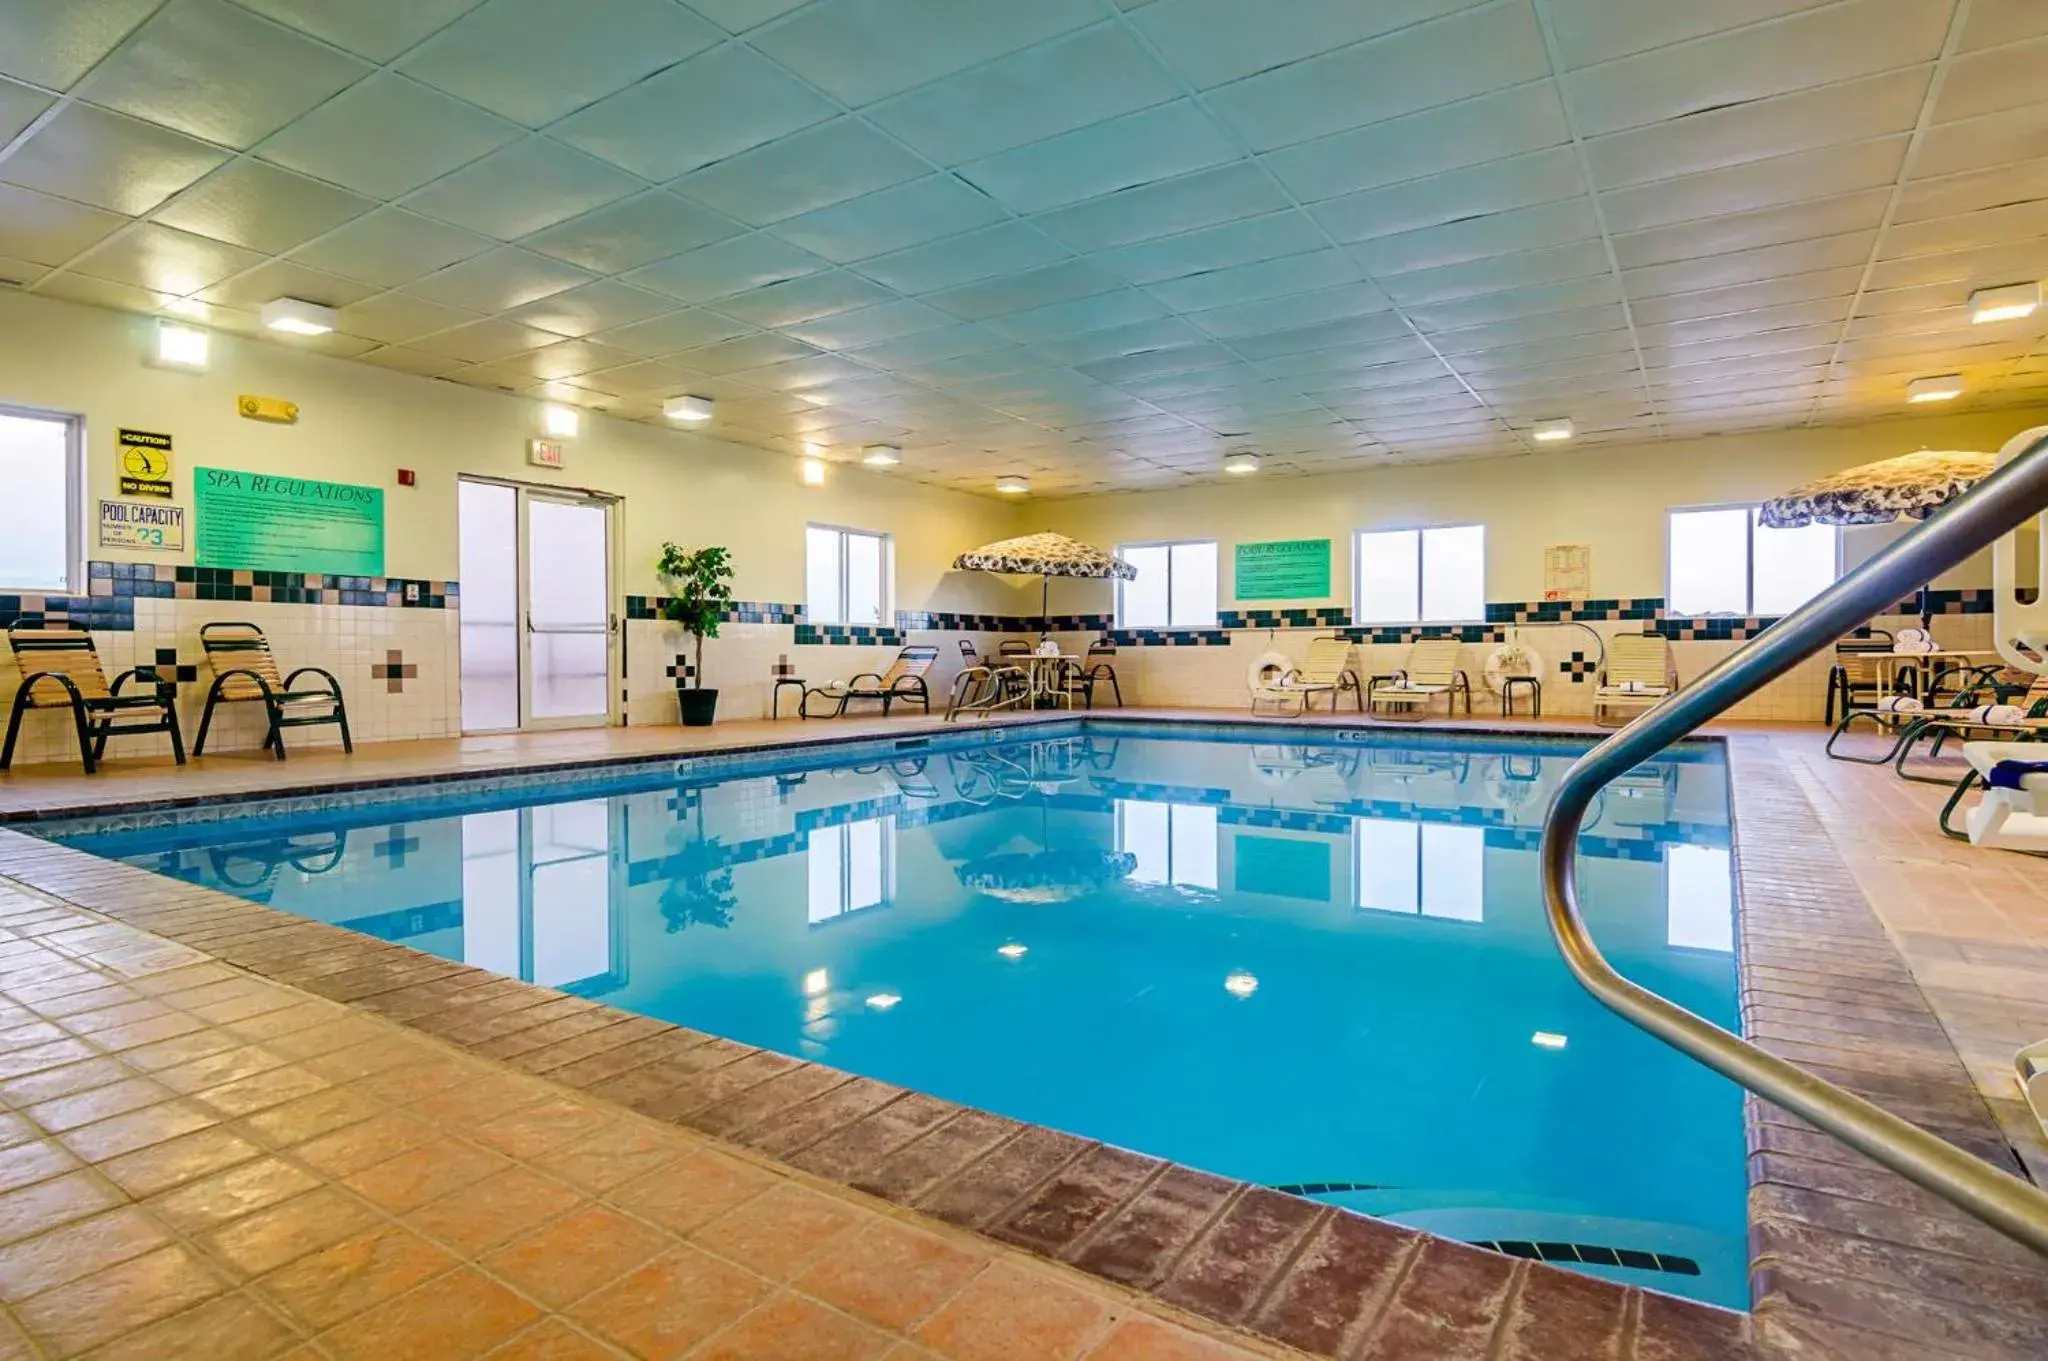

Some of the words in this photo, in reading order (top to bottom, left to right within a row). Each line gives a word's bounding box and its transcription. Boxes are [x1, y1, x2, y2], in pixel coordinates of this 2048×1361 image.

[126, 434, 167, 445] CAUTION
[540, 442, 562, 463] EXIT
[123, 482, 136, 490] NO
[138, 483, 169, 493] DIVING
[207, 470, 242, 490] SPA
[251, 475, 374, 504] REGULATIONS
[103, 503, 129, 521] POOL
[132, 505, 181, 526] CAPACITY
